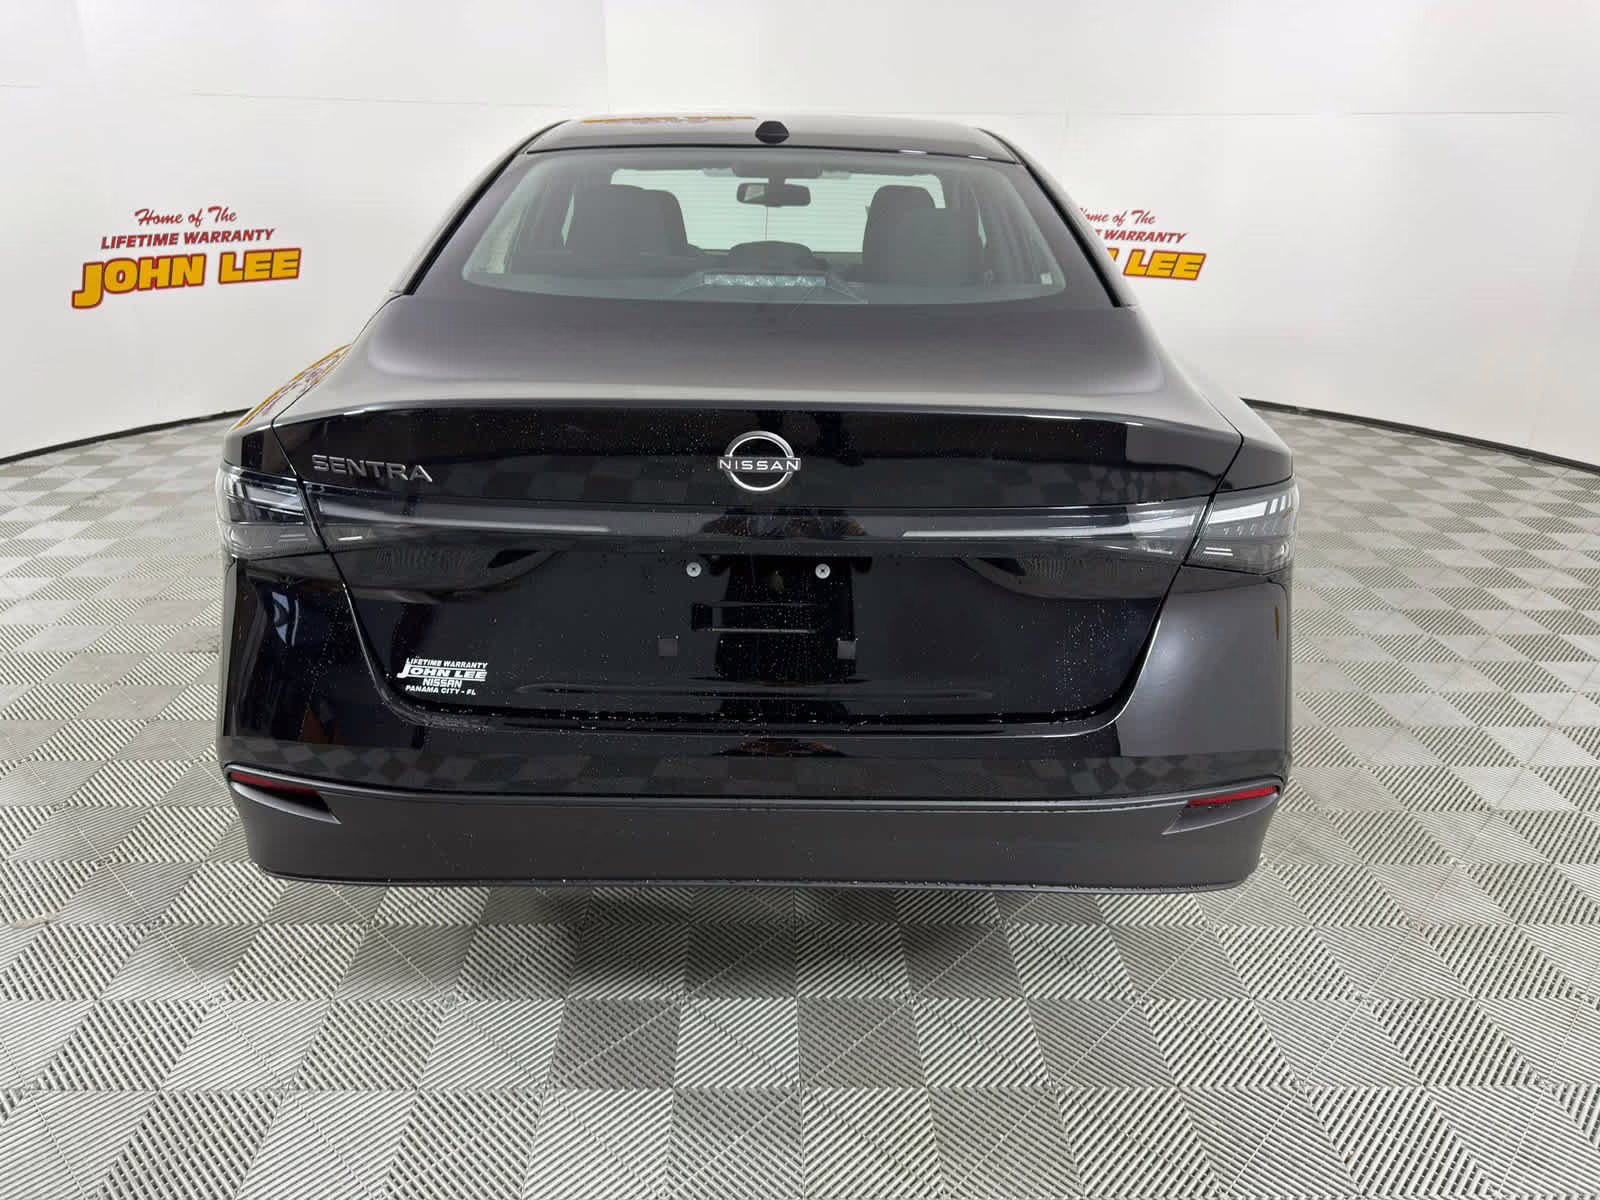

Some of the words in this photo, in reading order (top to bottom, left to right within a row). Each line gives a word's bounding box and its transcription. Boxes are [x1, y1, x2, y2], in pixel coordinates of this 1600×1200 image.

[134, 208, 183, 226] Home
[187, 208, 204, 228] of
[207, 206, 237, 223] The
[1080, 207, 1109, 222] me
[1112, 209, 1127, 226] of
[1131, 209, 1157, 225] The
[101, 232, 179, 250] LIFETIME
[184, 228, 275, 245] WARRANTY
[1104, 229, 1186, 243] WARRANTY
[1123, 248, 1206, 281] LEE
[72, 253, 207, 309] JOHN
[218, 248, 302, 284] LEE
[311, 454, 433, 482] SENTRA
[719, 459, 799, 471] NISSAN
[397, 664, 451, 679] JOHN
[454, 671, 488, 679] LEE
[405, 658, 442, 666] LIFETIME
[443, 660, 488, 669] WARRANTY
[405, 685, 439, 694] PANAMA
[440, 687, 460, 695] CITY
[422, 678, 462, 688] NISSAN
